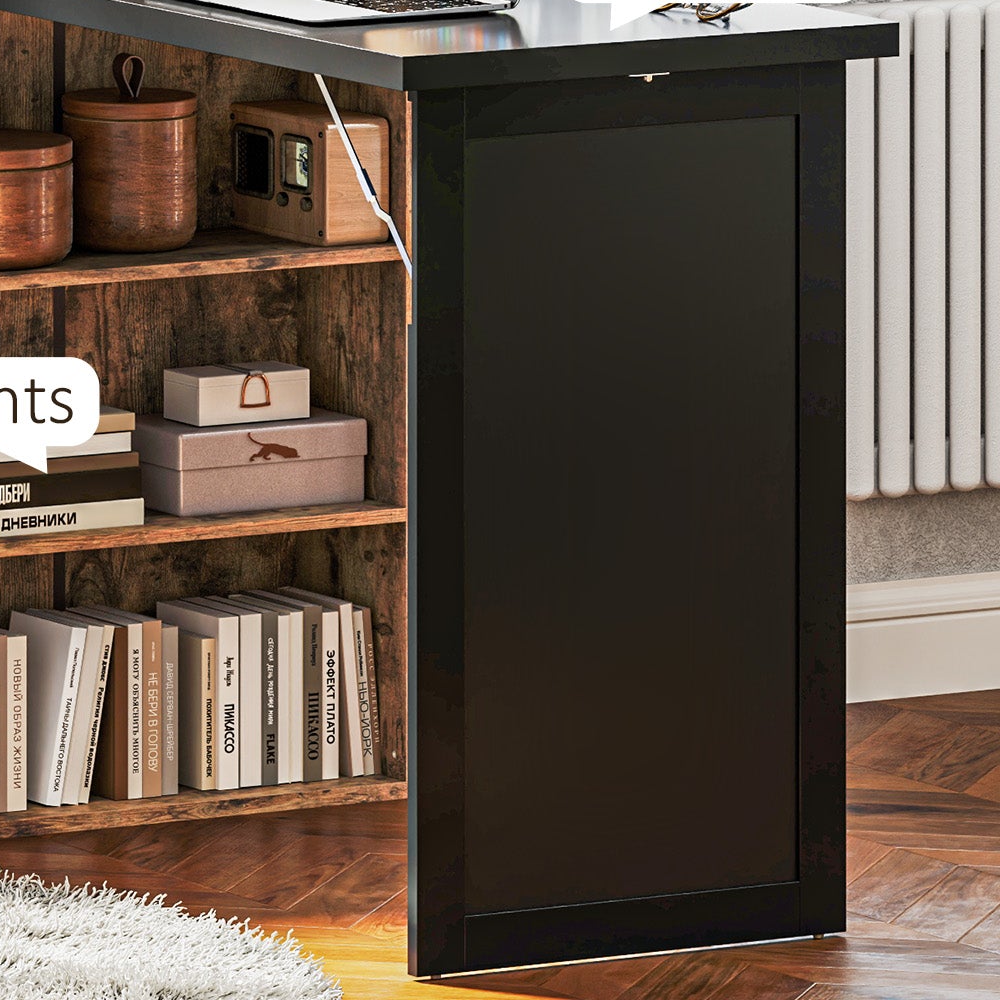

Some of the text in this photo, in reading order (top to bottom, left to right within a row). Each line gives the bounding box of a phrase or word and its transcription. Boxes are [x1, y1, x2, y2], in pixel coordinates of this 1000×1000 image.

[1, 512, 77, 532] ДНЕВНИКИ
[148, 672, 158, 686] НЕ
[165, 662, 174, 689] ДАВИД
[148, 689, 158, 717] БЕРИ
[326, 650, 335, 744] ЭФФЕКТ ПЛАТО
[13, 659, 23, 789] НОВЫЙ ОБРАЗ ЖИЗНИ
[224, 704, 235, 754] ПИКАССО
[307, 692, 320, 760] ПИКАССО
[147, 730, 158, 772] ГОЛОВУ
[266, 734, 275, 765] FLAKE
[53, 759, 64, 792] ВОСТОКА
